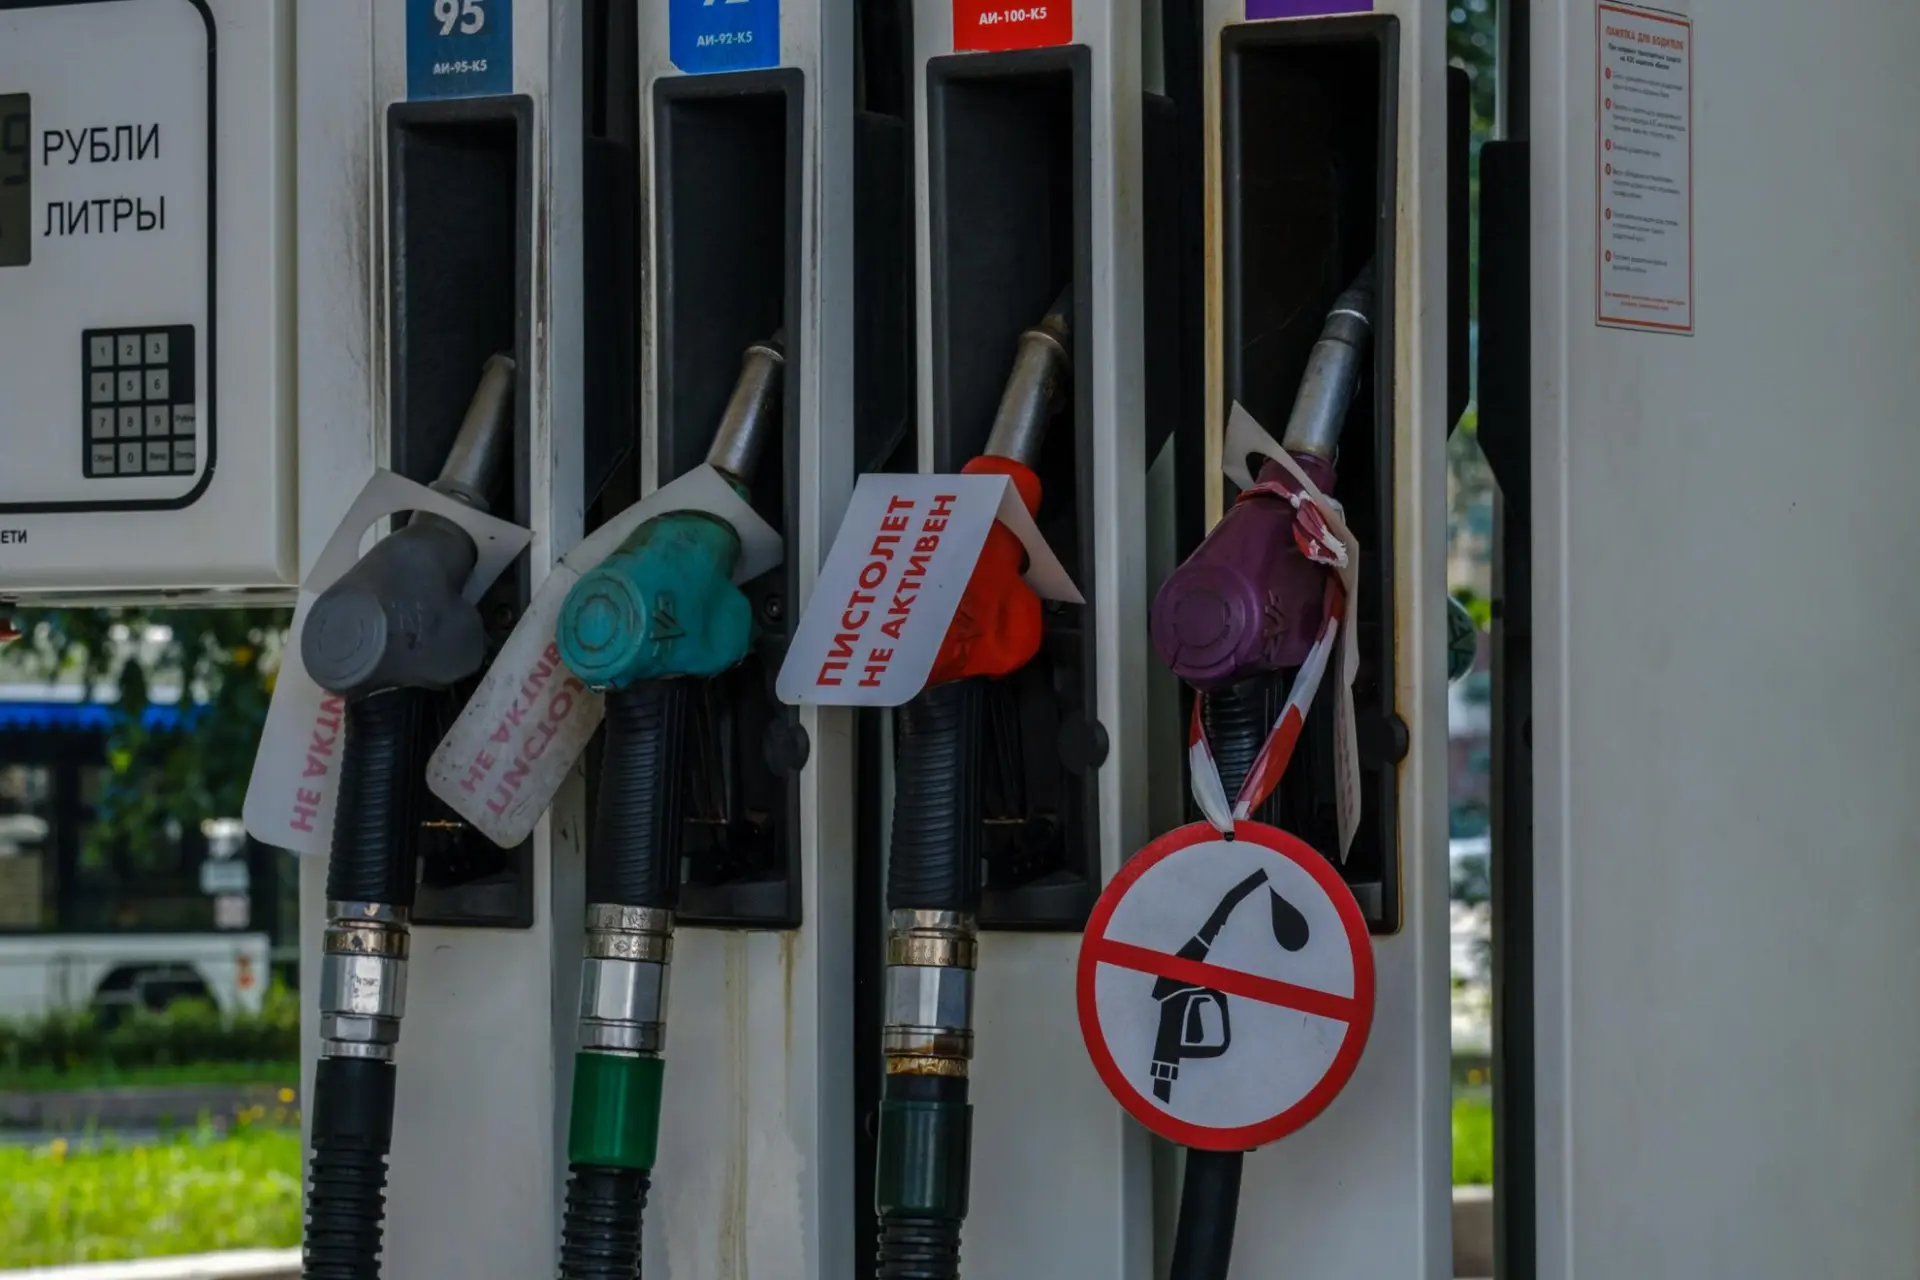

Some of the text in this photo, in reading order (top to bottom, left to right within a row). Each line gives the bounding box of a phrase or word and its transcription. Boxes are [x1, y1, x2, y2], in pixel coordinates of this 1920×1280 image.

[434, 0, 484, 35] 95
[979, 7, 1047, 25] АИ-100-К5
[696, 31, 753, 47] АИ-92-К5
[433, 59, 487, 75] АИ-95-К5
[43, 123, 159, 166] РУБЛИ
[44, 196, 164, 236] ЛИТРЫ
[101, 346, 106, 357] 1
[126, 344, 133, 356] 2
[154, 343, 160, 354] 3
[100, 382, 106, 392] 4
[127, 380, 133, 391] 5
[154, 379, 160, 390] 6
[100, 417, 106, 428] 7
[127, 417, 133, 427] 8
[154, 415, 161, 426] 9
[128, 452, 133, 463] 0
[816, 495, 915, 686] ПИСТОЛЕТ
[858, 495, 957, 686] НЕ АКТИВЕН
